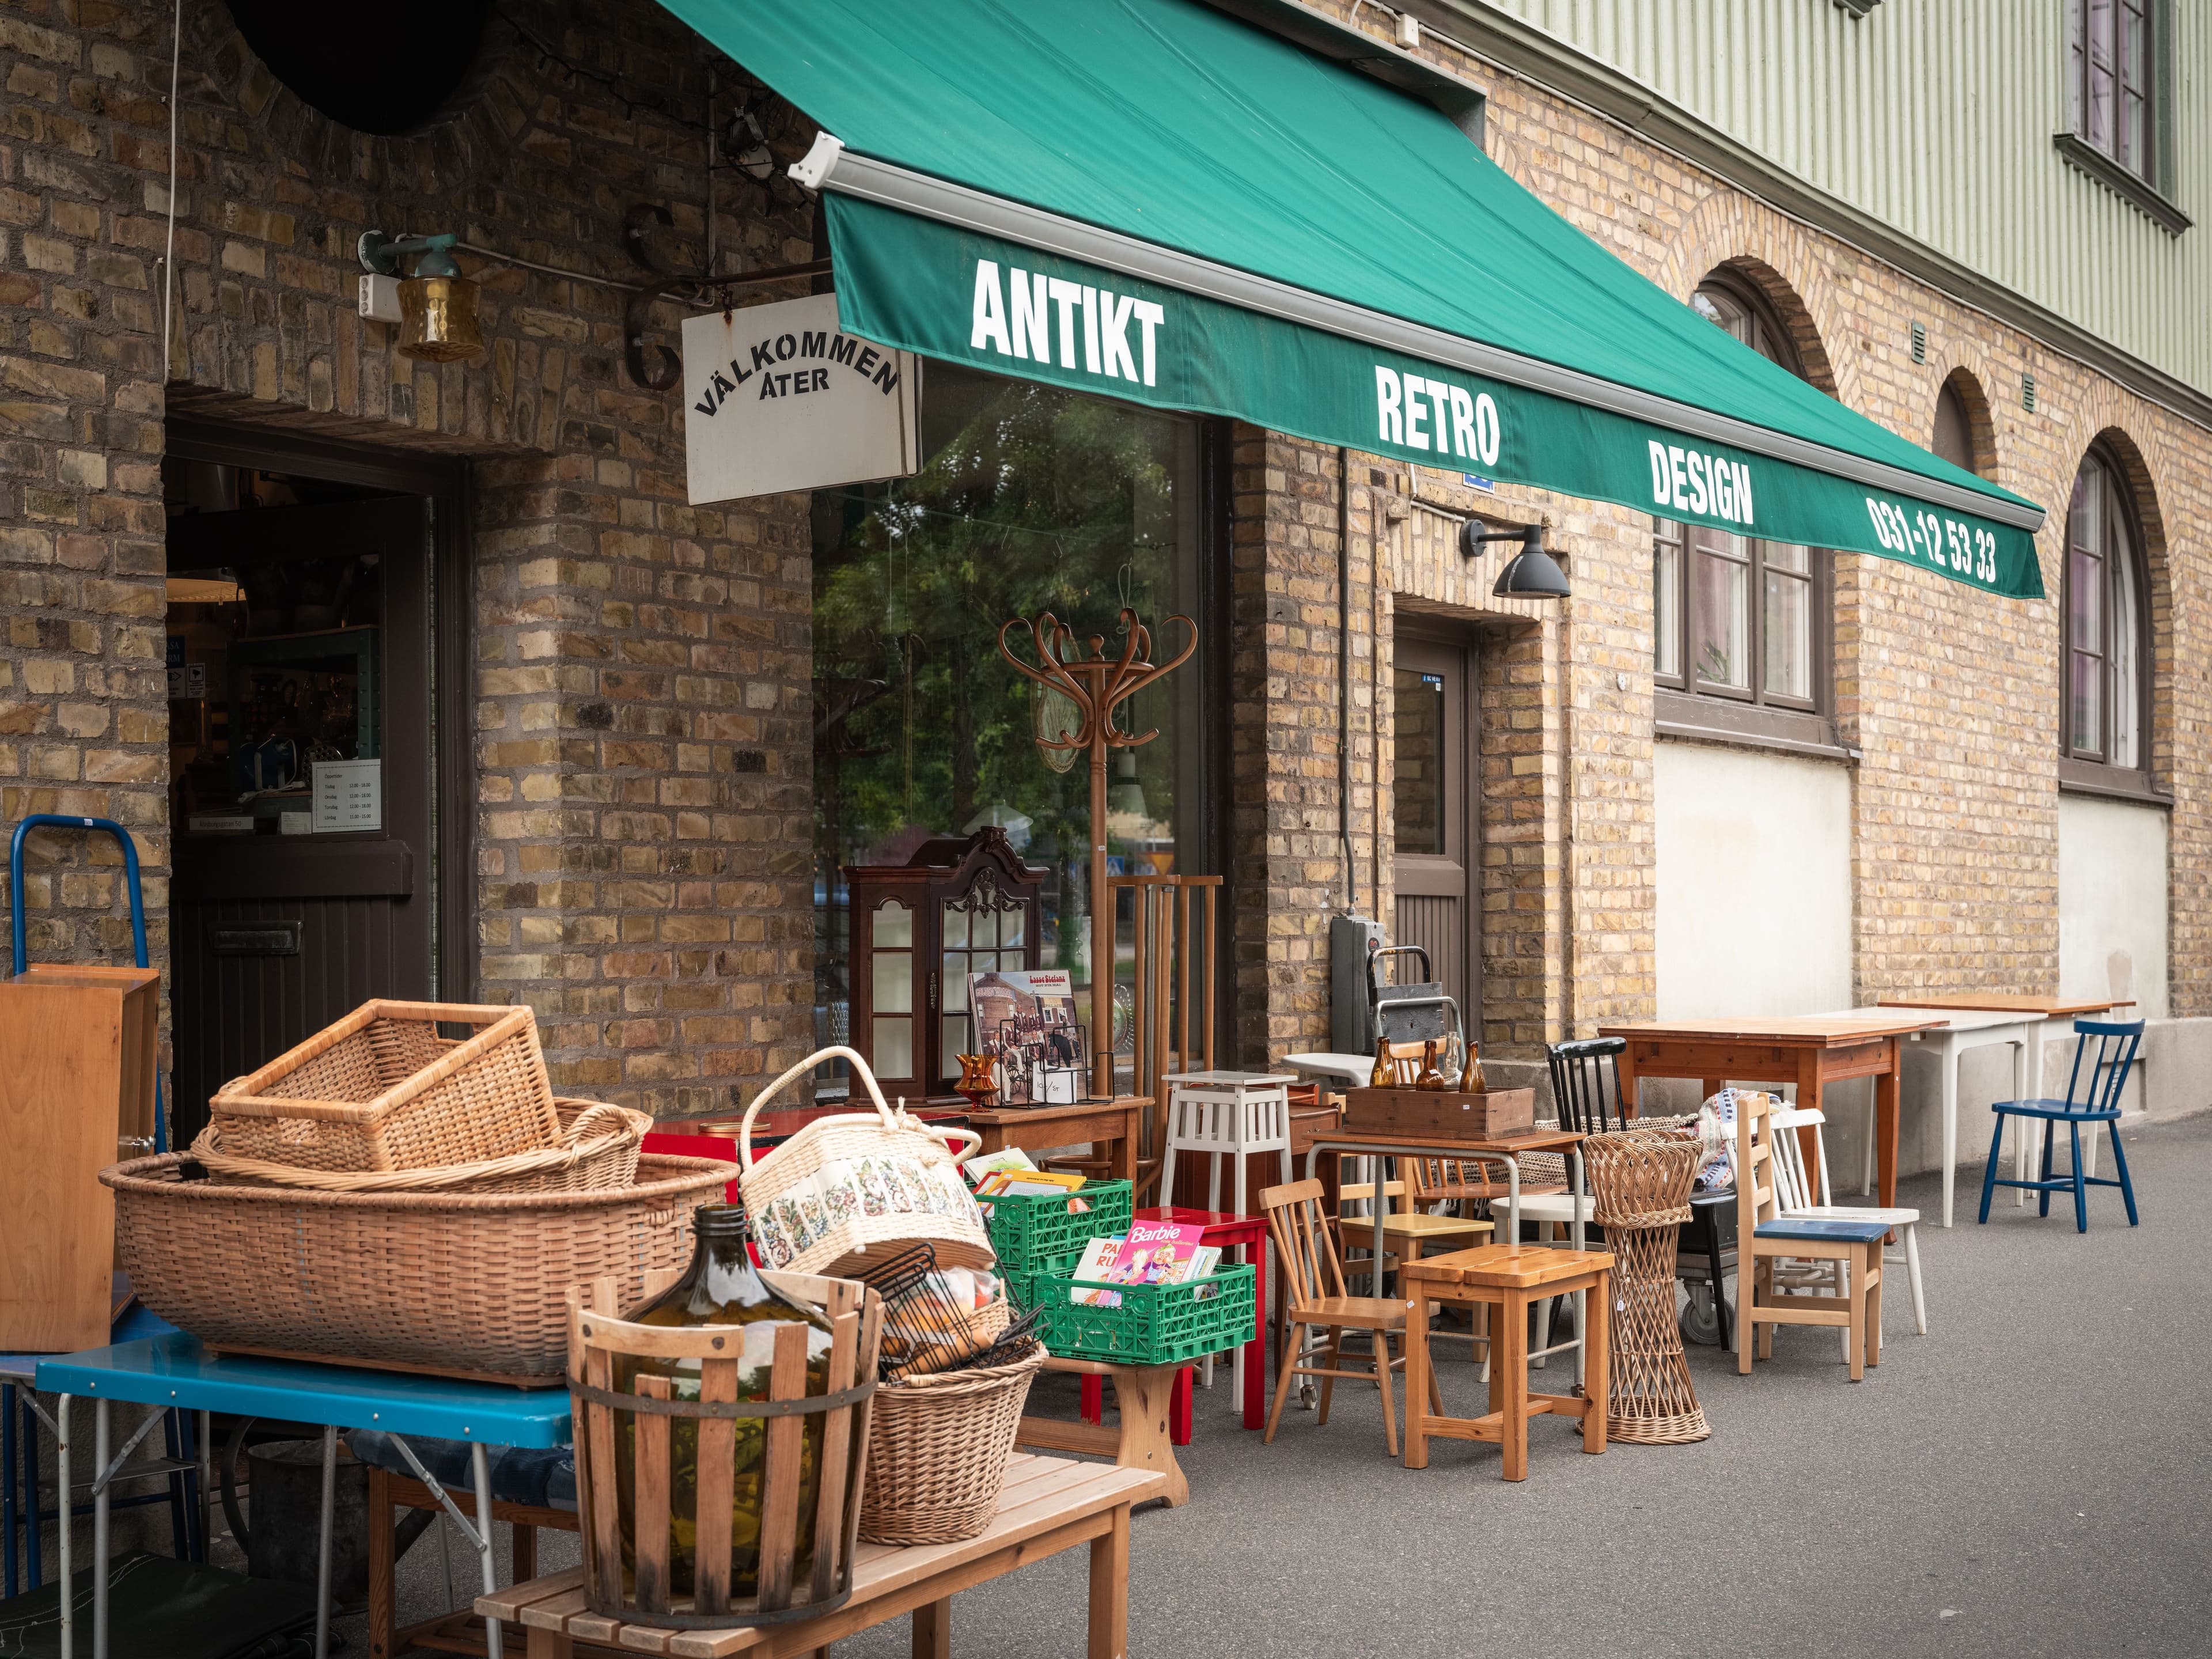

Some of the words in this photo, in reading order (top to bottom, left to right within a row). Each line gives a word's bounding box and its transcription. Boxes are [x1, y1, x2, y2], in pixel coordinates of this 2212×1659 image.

[971, 259, 1164, 387] ANTIKT
[694, 331, 897, 416] VÄLKOMMEN
[759, 368, 830, 400] ÅTER
[1375, 365, 1500, 466] RETRO
[1648, 440, 1753, 524] DESIGN
[1866, 498, 1946, 566] 031-12
[1945, 519, 1972, 575] 53
[1976, 528, 1996, 582] 33
[1029, 975, 1045, 984] Lasse
[1130, 1226, 1181, 1243] Barbie
